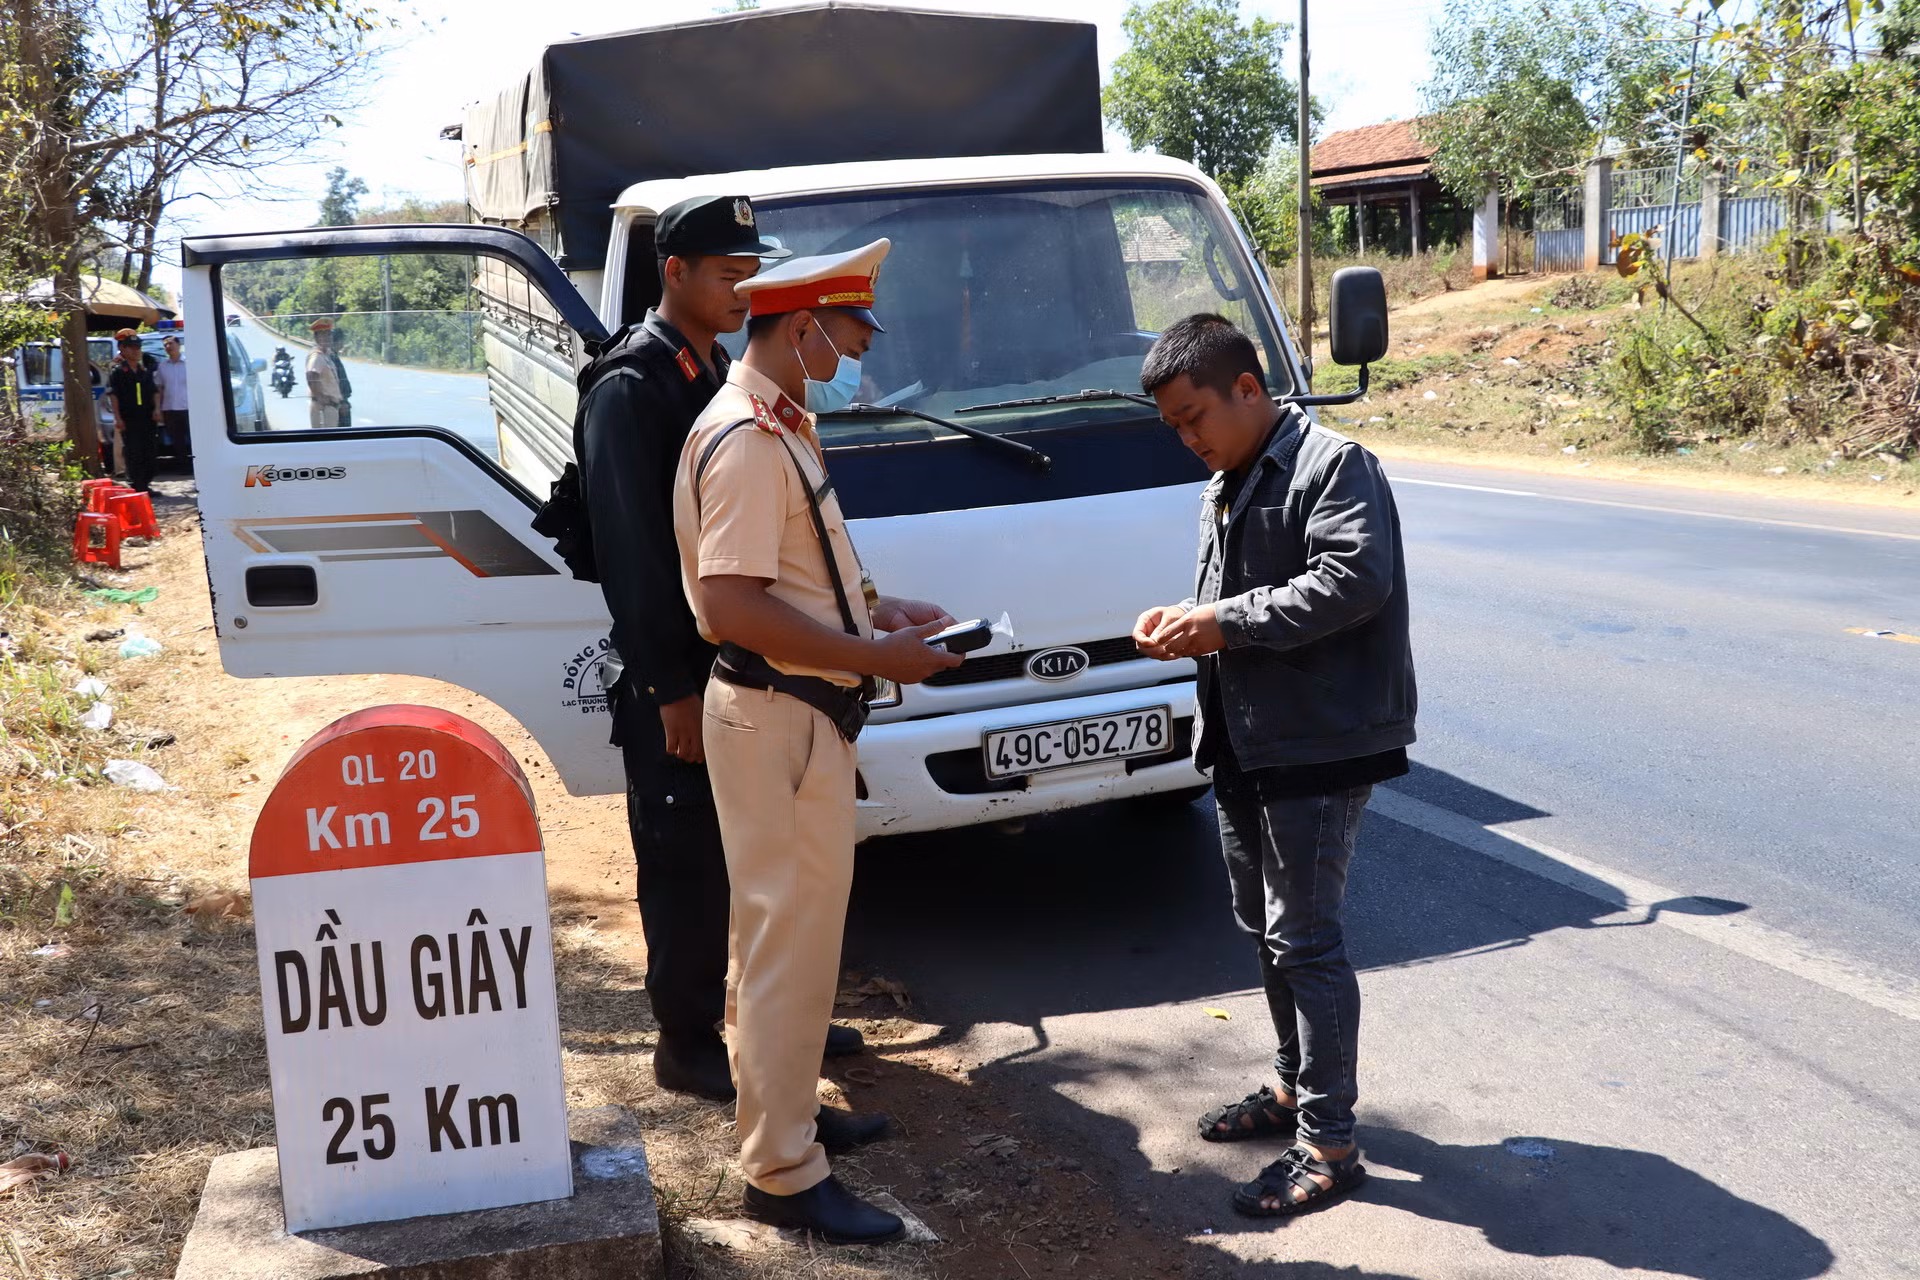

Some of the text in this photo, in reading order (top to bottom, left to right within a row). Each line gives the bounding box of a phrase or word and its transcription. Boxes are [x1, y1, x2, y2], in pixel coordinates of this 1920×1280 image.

[244, 464, 347, 487] K3000S
[1041, 655, 1079, 674] KIA
[342, 749, 437, 786] QL 20
[996, 713, 1162, 770] 49C-052.78
[306, 794, 480, 852] Km 25
[274, 908, 532, 1035] DẦU GIÂY
[322, 1083, 521, 1165] 25 Km
